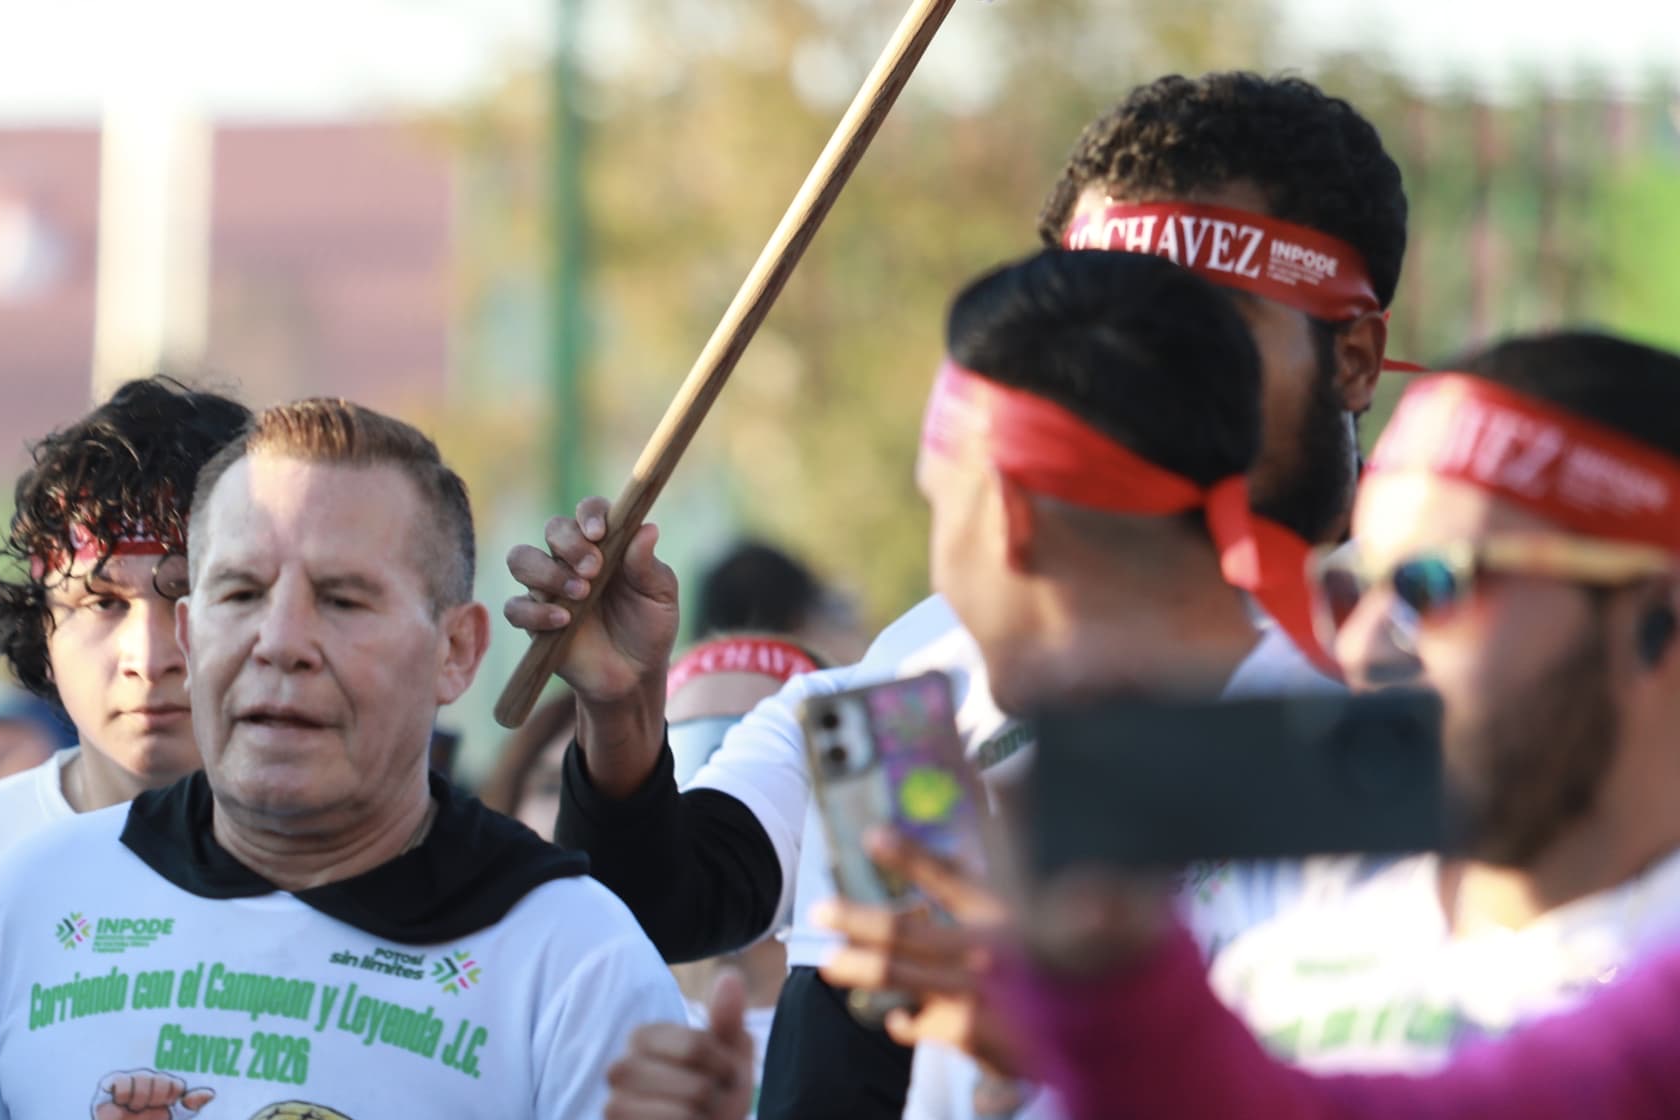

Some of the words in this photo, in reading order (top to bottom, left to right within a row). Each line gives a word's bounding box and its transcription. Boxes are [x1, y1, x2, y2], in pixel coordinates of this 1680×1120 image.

[1102, 213, 1264, 278] CHAVEZ
[1269, 239, 1338, 278] INPODE
[96, 917, 175, 934] INPODE
[29, 965, 128, 1031] Corriendo
[131, 970, 175, 1010] con
[177, 961, 204, 1008] el
[203, 961, 315, 1022] Campeon
[314, 984, 339, 1032] y
[337, 981, 444, 1059] Leyenda
[441, 1019, 488, 1079] J.C.
[155, 1023, 243, 1077] Chavez
[246, 1031, 311, 1085] 2026
